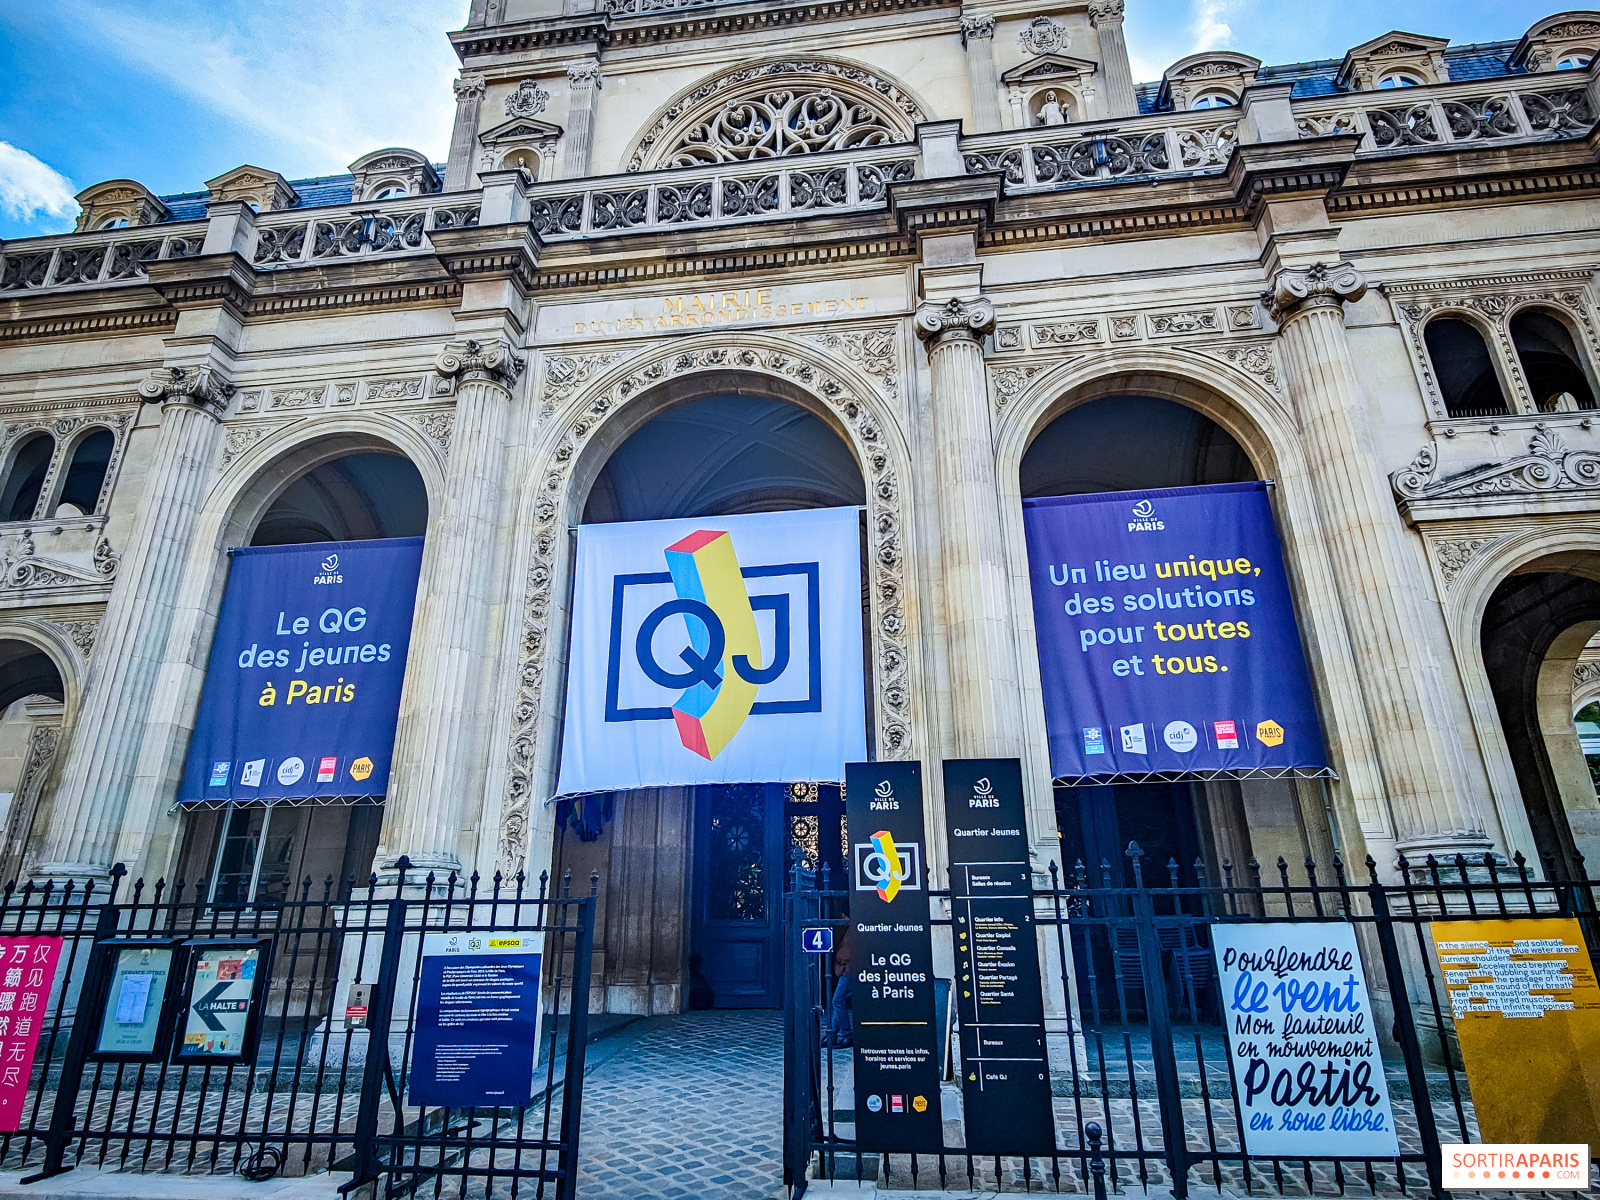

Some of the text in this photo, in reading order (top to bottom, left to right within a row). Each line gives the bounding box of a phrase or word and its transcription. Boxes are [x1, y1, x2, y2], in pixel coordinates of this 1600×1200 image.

[663, 288, 773, 313] MAIRIE
[573, 320, 603, 334] DU
[654, 297, 868, 330] ARRONDISSEMENT
[1127, 521, 1165, 532] PARIS
[1049, 554, 1261, 585] Un lieu unique,
[313, 575, 343, 585] PARIS
[1064, 585, 1255, 616] des solutions
[276, 606, 367, 635] Le QG
[635, 593, 790, 690] QJ
[1080, 619, 1251, 652] pour toutes
[238, 641, 392, 673] des jeunes
[1112, 654, 1229, 676] et tous.
[258, 677, 356, 706] à Paris
[1169, 731, 1184, 740] cidj
[1259, 728, 1281, 738] PARIS
[352, 763, 371, 773] PARIS
[870, 801, 900, 810] PARIS
[968, 798, 1000, 808] PARIS
[953, 828, 1020, 837] Quartier Jeunes
[863, 852, 911, 882] QJ
[857, 922, 924, 932] Quartier Jeunes
[812, 931, 823, 949] 4
[1531, 939, 1564, 947] solitude
[871, 953, 912, 966] Le QG
[1223, 945, 1353, 979] Pourfendre
[1440, 956, 1470, 964] Burning
[1478, 961, 1528, 969] Accelerated
[858, 969, 926, 985] des jeunes
[1494, 969, 1529, 977] bubbling
[1530, 967, 1562, 976] surface
[871, 985, 915, 999] à Paris
[1230, 971, 1361, 1013] le vent
[1486, 989, 1530, 997] exhaustion
[1521, 995, 1555, 1003] muscles
[198, 1002, 238, 1011] LA HALTE
[1532, 1003, 1575, 1011] happiness
[1235, 1012, 1365, 1041] Mon fauteuil
[1036, 1038, 1041, 1046] 1
[1237, 1038, 1373, 1058] en mouvement
[879, 1062, 912, 1071] jeunes.paris
[1244, 1057, 1381, 1107] Partir
[1249, 1106, 1389, 1133] en roue libre.
